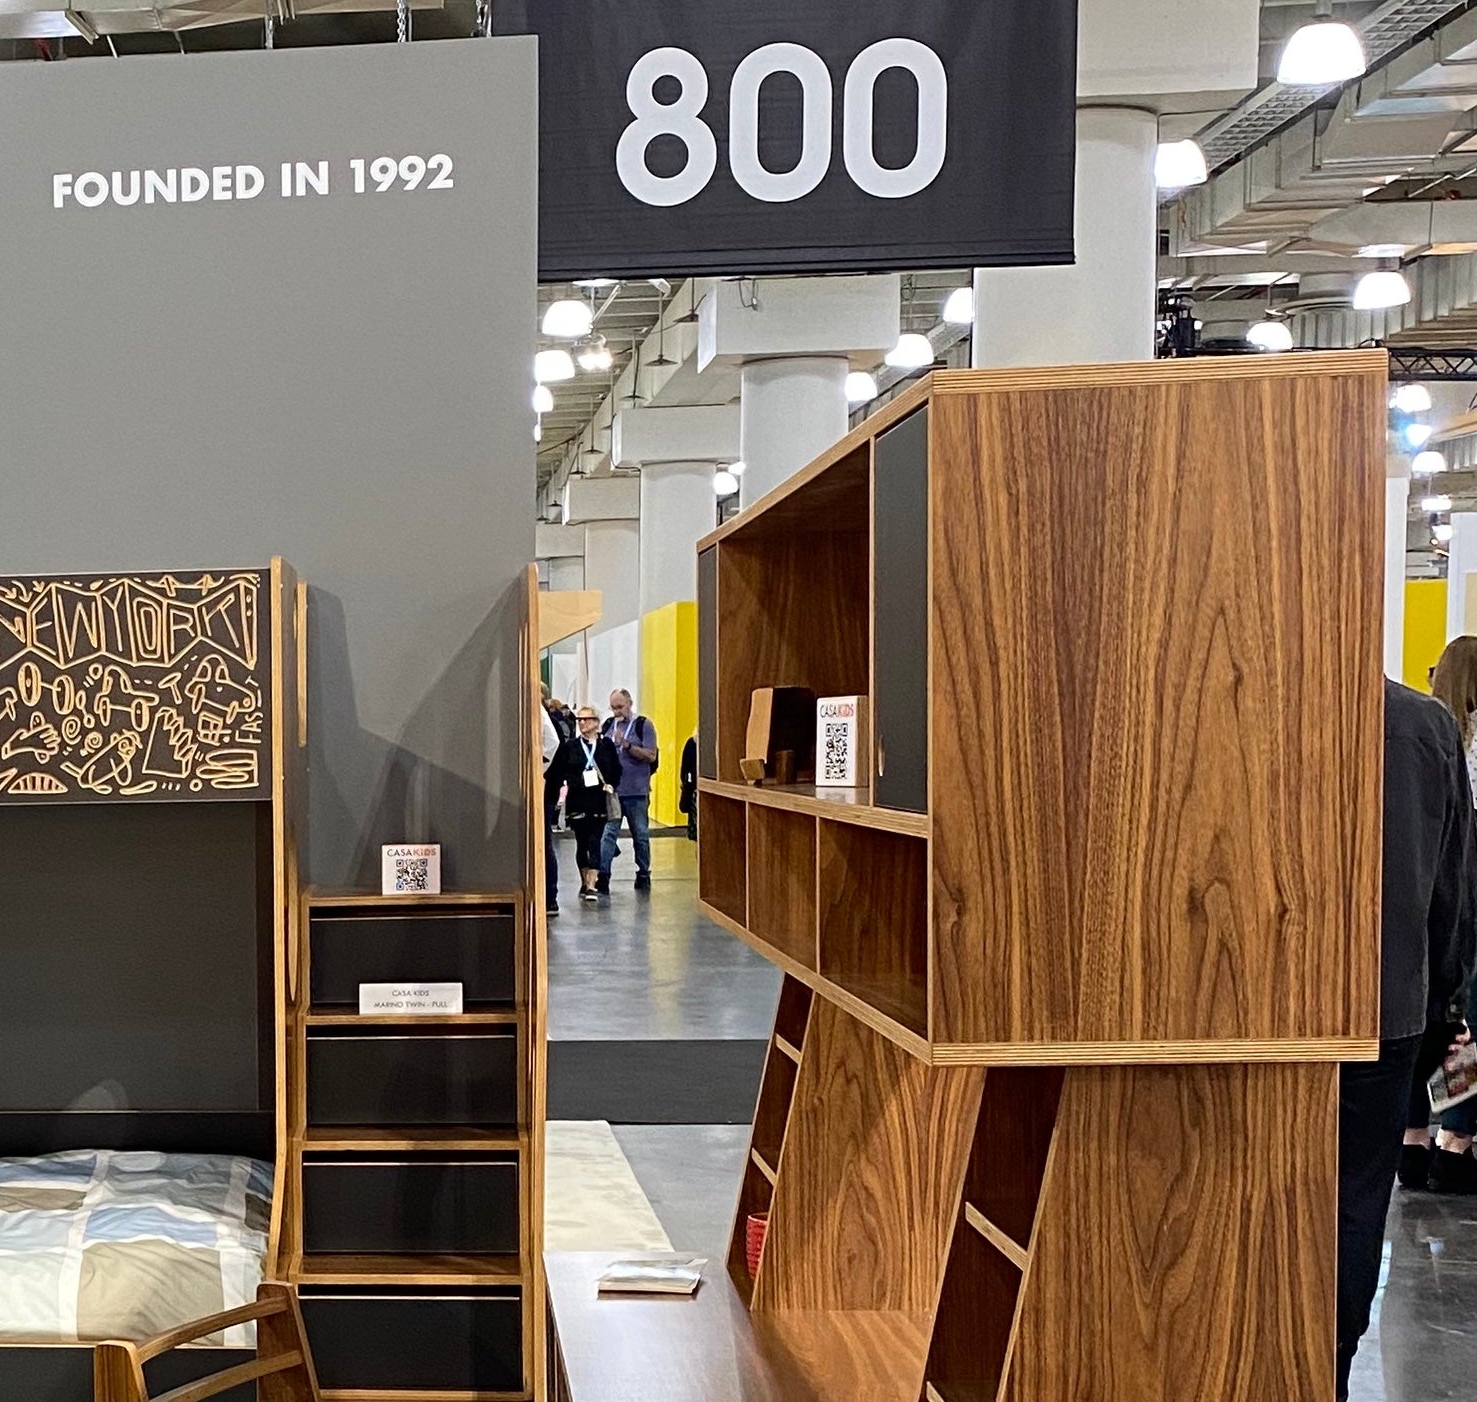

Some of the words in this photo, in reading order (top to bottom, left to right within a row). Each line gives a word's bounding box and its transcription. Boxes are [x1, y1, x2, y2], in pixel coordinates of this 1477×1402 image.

[616, 37, 948, 207] 800
[53, 165, 265, 208] FOUNDED
[281, 161, 329, 197] IN
[350, 153, 454, 194] 1992
